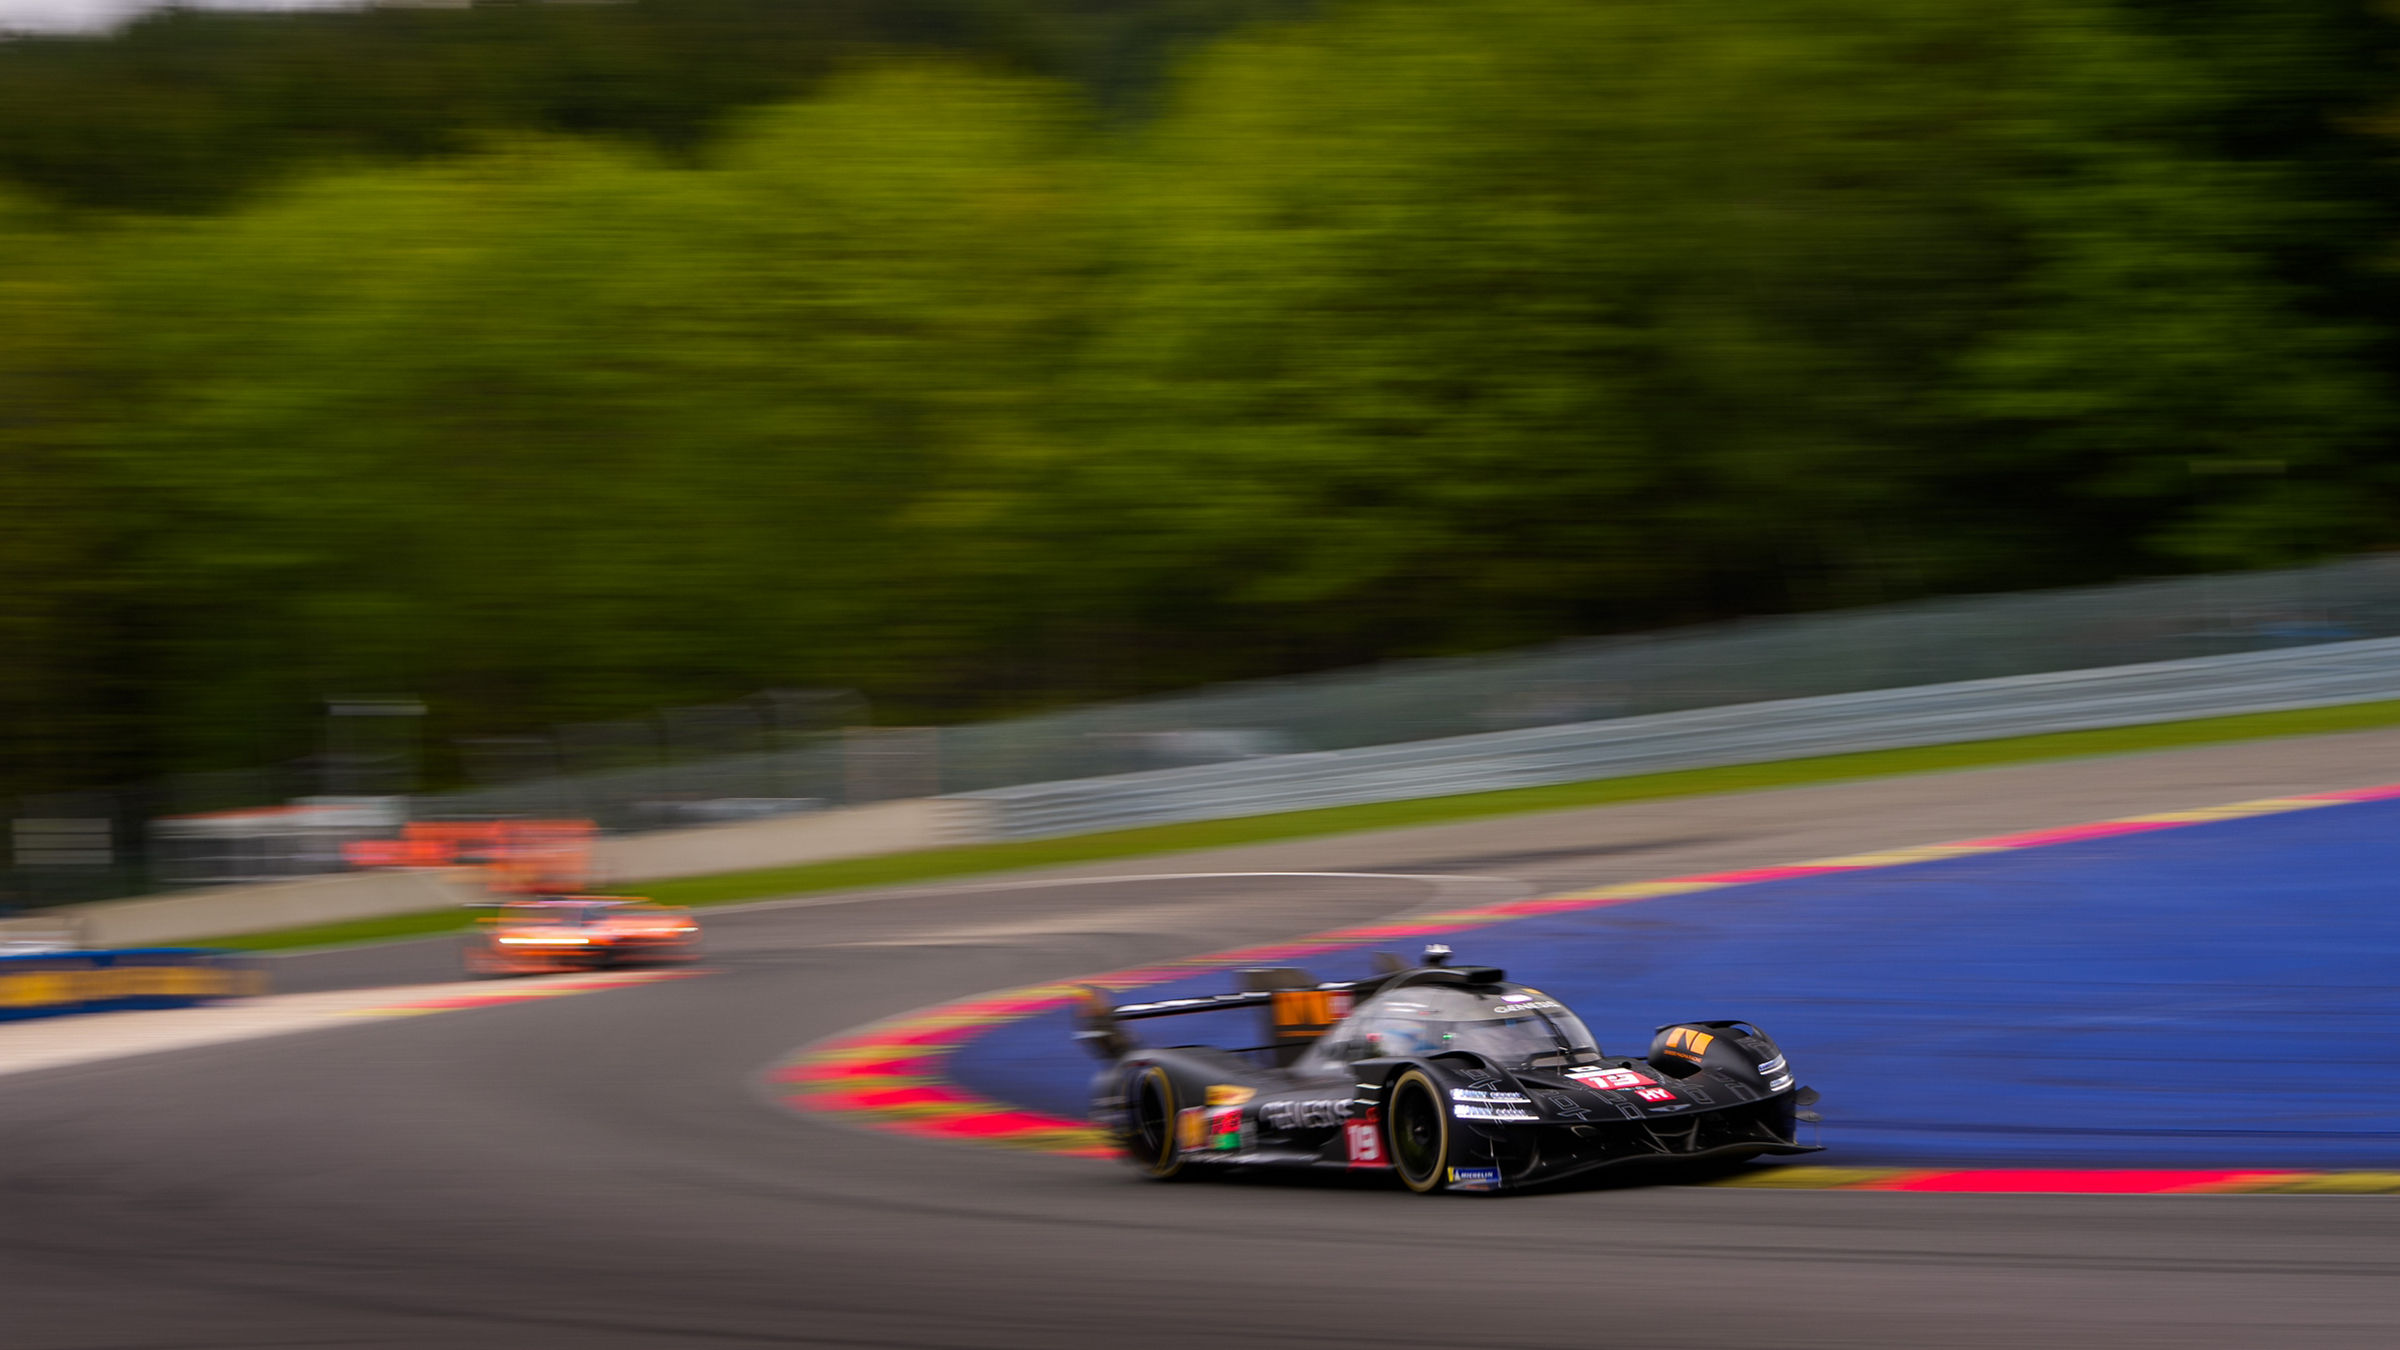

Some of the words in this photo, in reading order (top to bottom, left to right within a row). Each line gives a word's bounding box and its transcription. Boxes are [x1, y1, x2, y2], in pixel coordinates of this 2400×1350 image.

[1588, 1074, 1640, 1089] 19
[1637, 1087, 1670, 1101] HY
[1347, 1124, 1380, 1162] 19
[1460, 1171, 1494, 1180] MICHELIN
